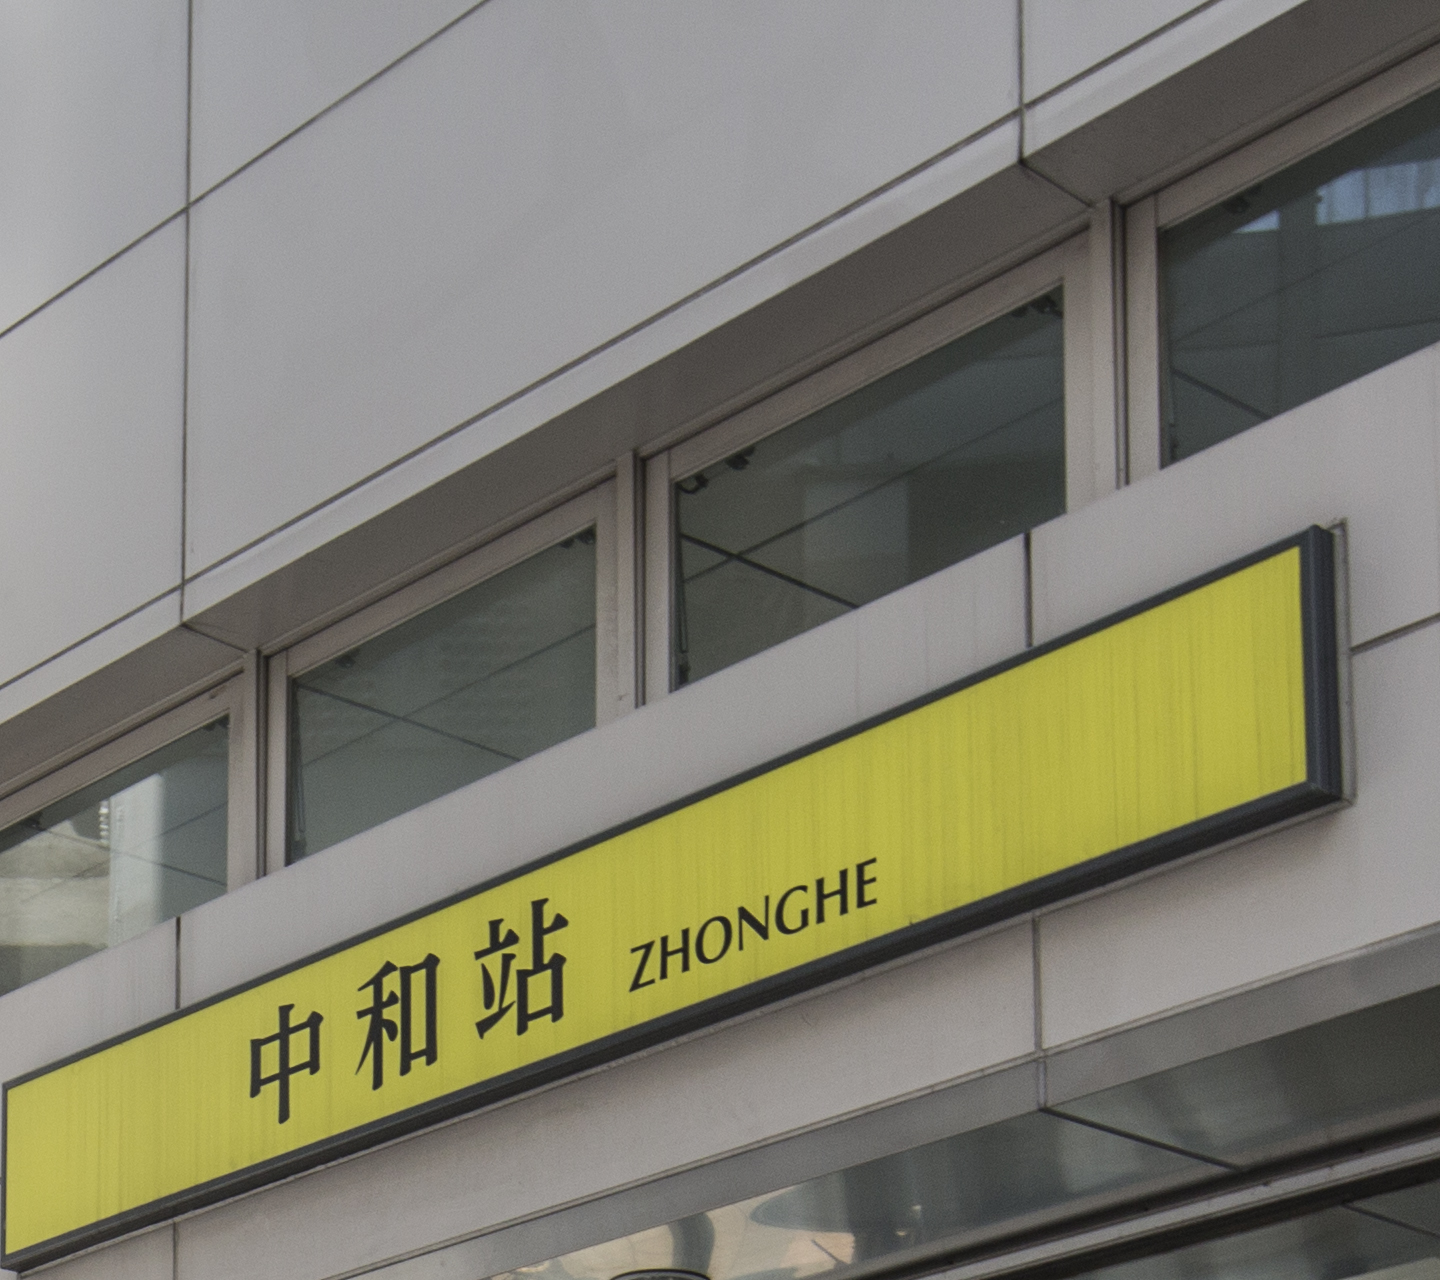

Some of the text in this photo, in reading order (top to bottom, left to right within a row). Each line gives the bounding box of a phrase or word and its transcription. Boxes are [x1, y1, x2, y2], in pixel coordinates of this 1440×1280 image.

[248, 896, 570, 1126] 中和站
[627, 856, 880, 993] ZHONGHE
